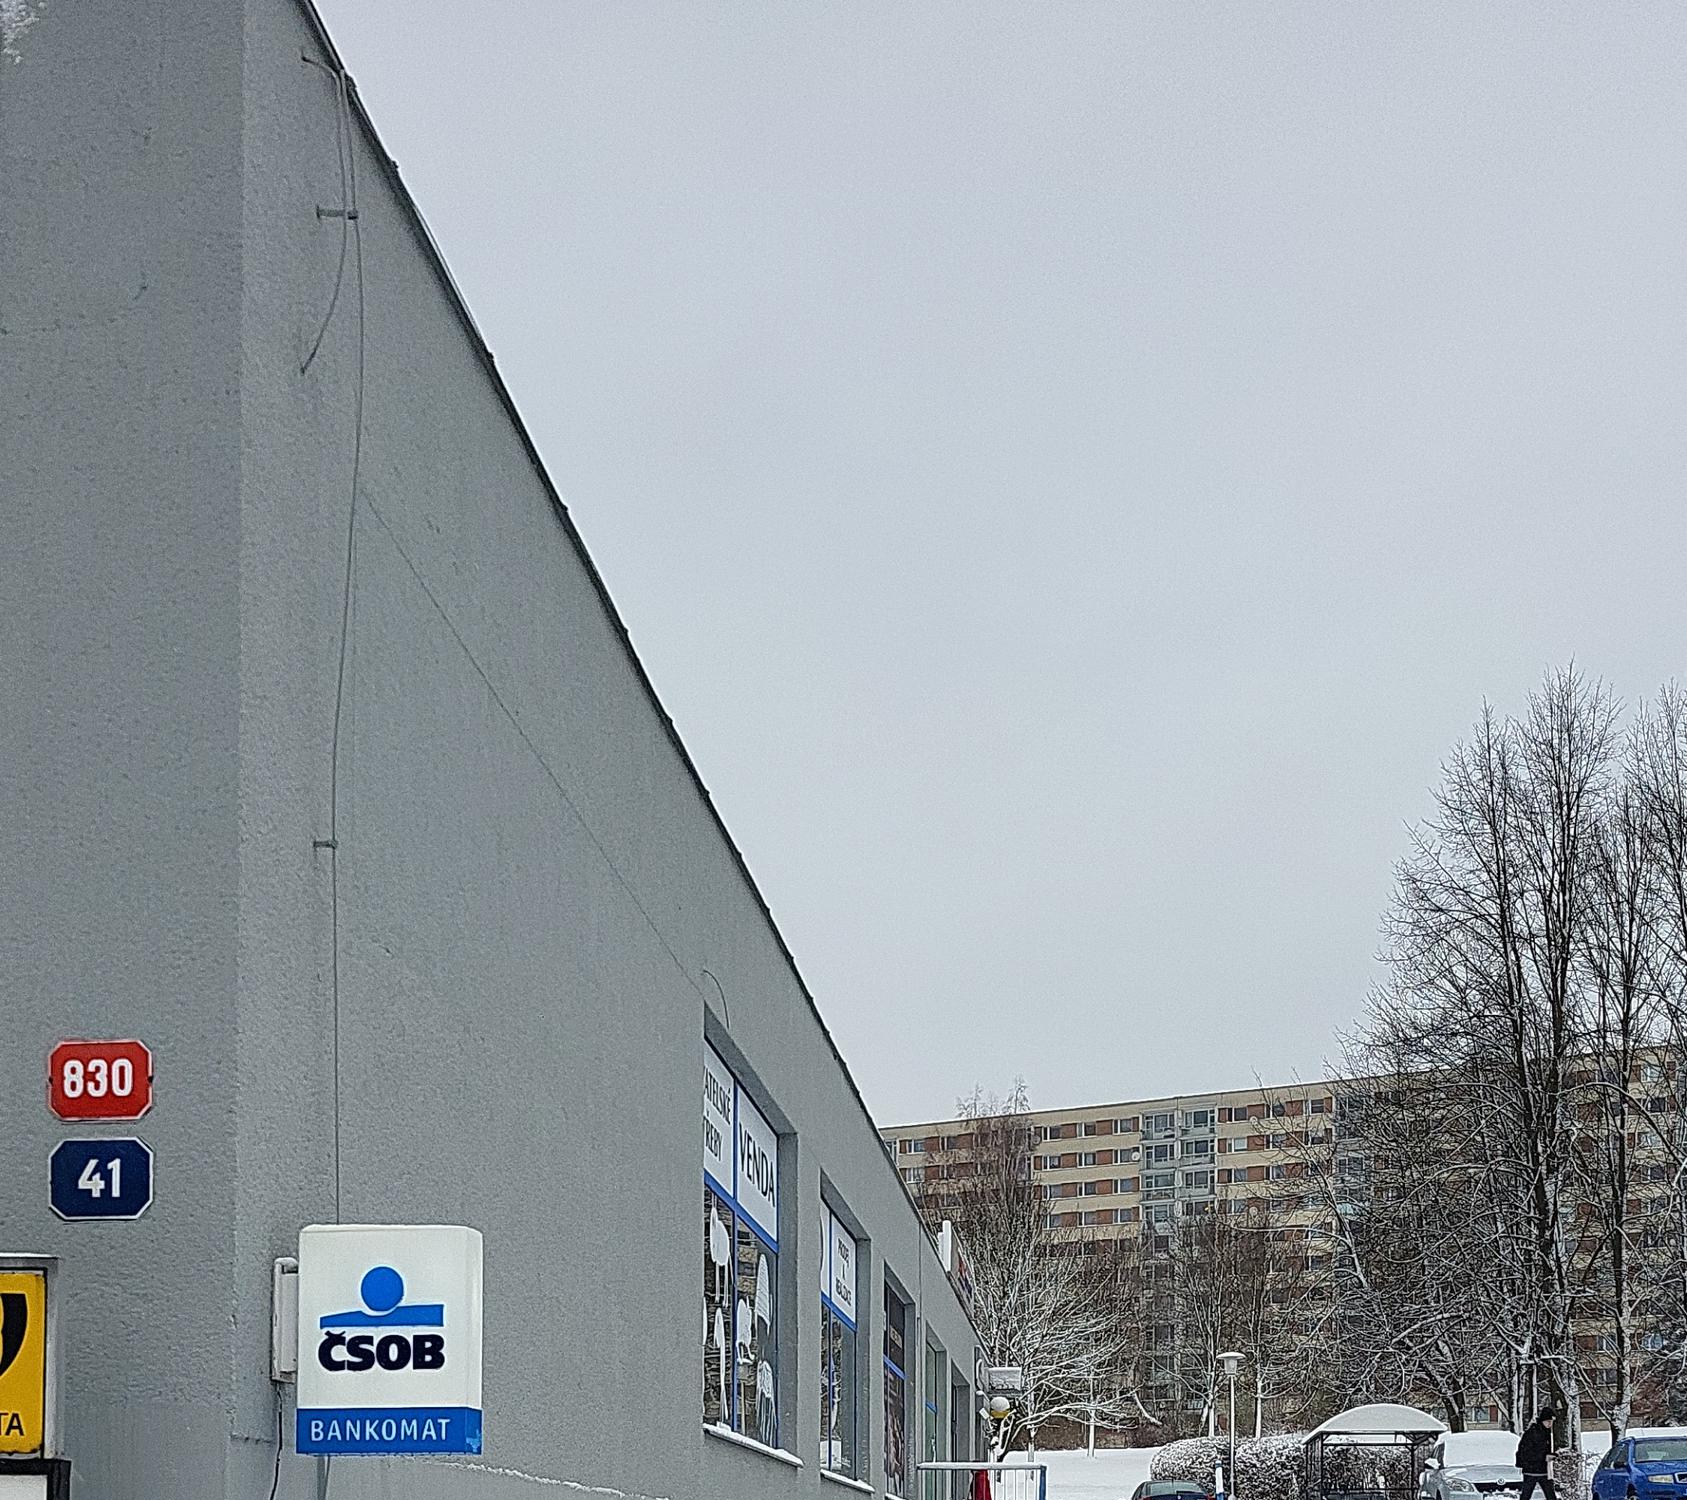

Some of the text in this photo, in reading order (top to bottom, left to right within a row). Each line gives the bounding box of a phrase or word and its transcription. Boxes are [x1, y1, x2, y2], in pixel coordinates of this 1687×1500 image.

[63, 1058, 133, 1098] 830
[704, 1065, 731, 1125] ATELSKÉ
[78, 1158, 121, 1198] 41
[739, 1121, 776, 1207] VENDA
[318, 1330, 446, 1372] ČSOB
[311, 1419, 451, 1441] BANKOMAT
